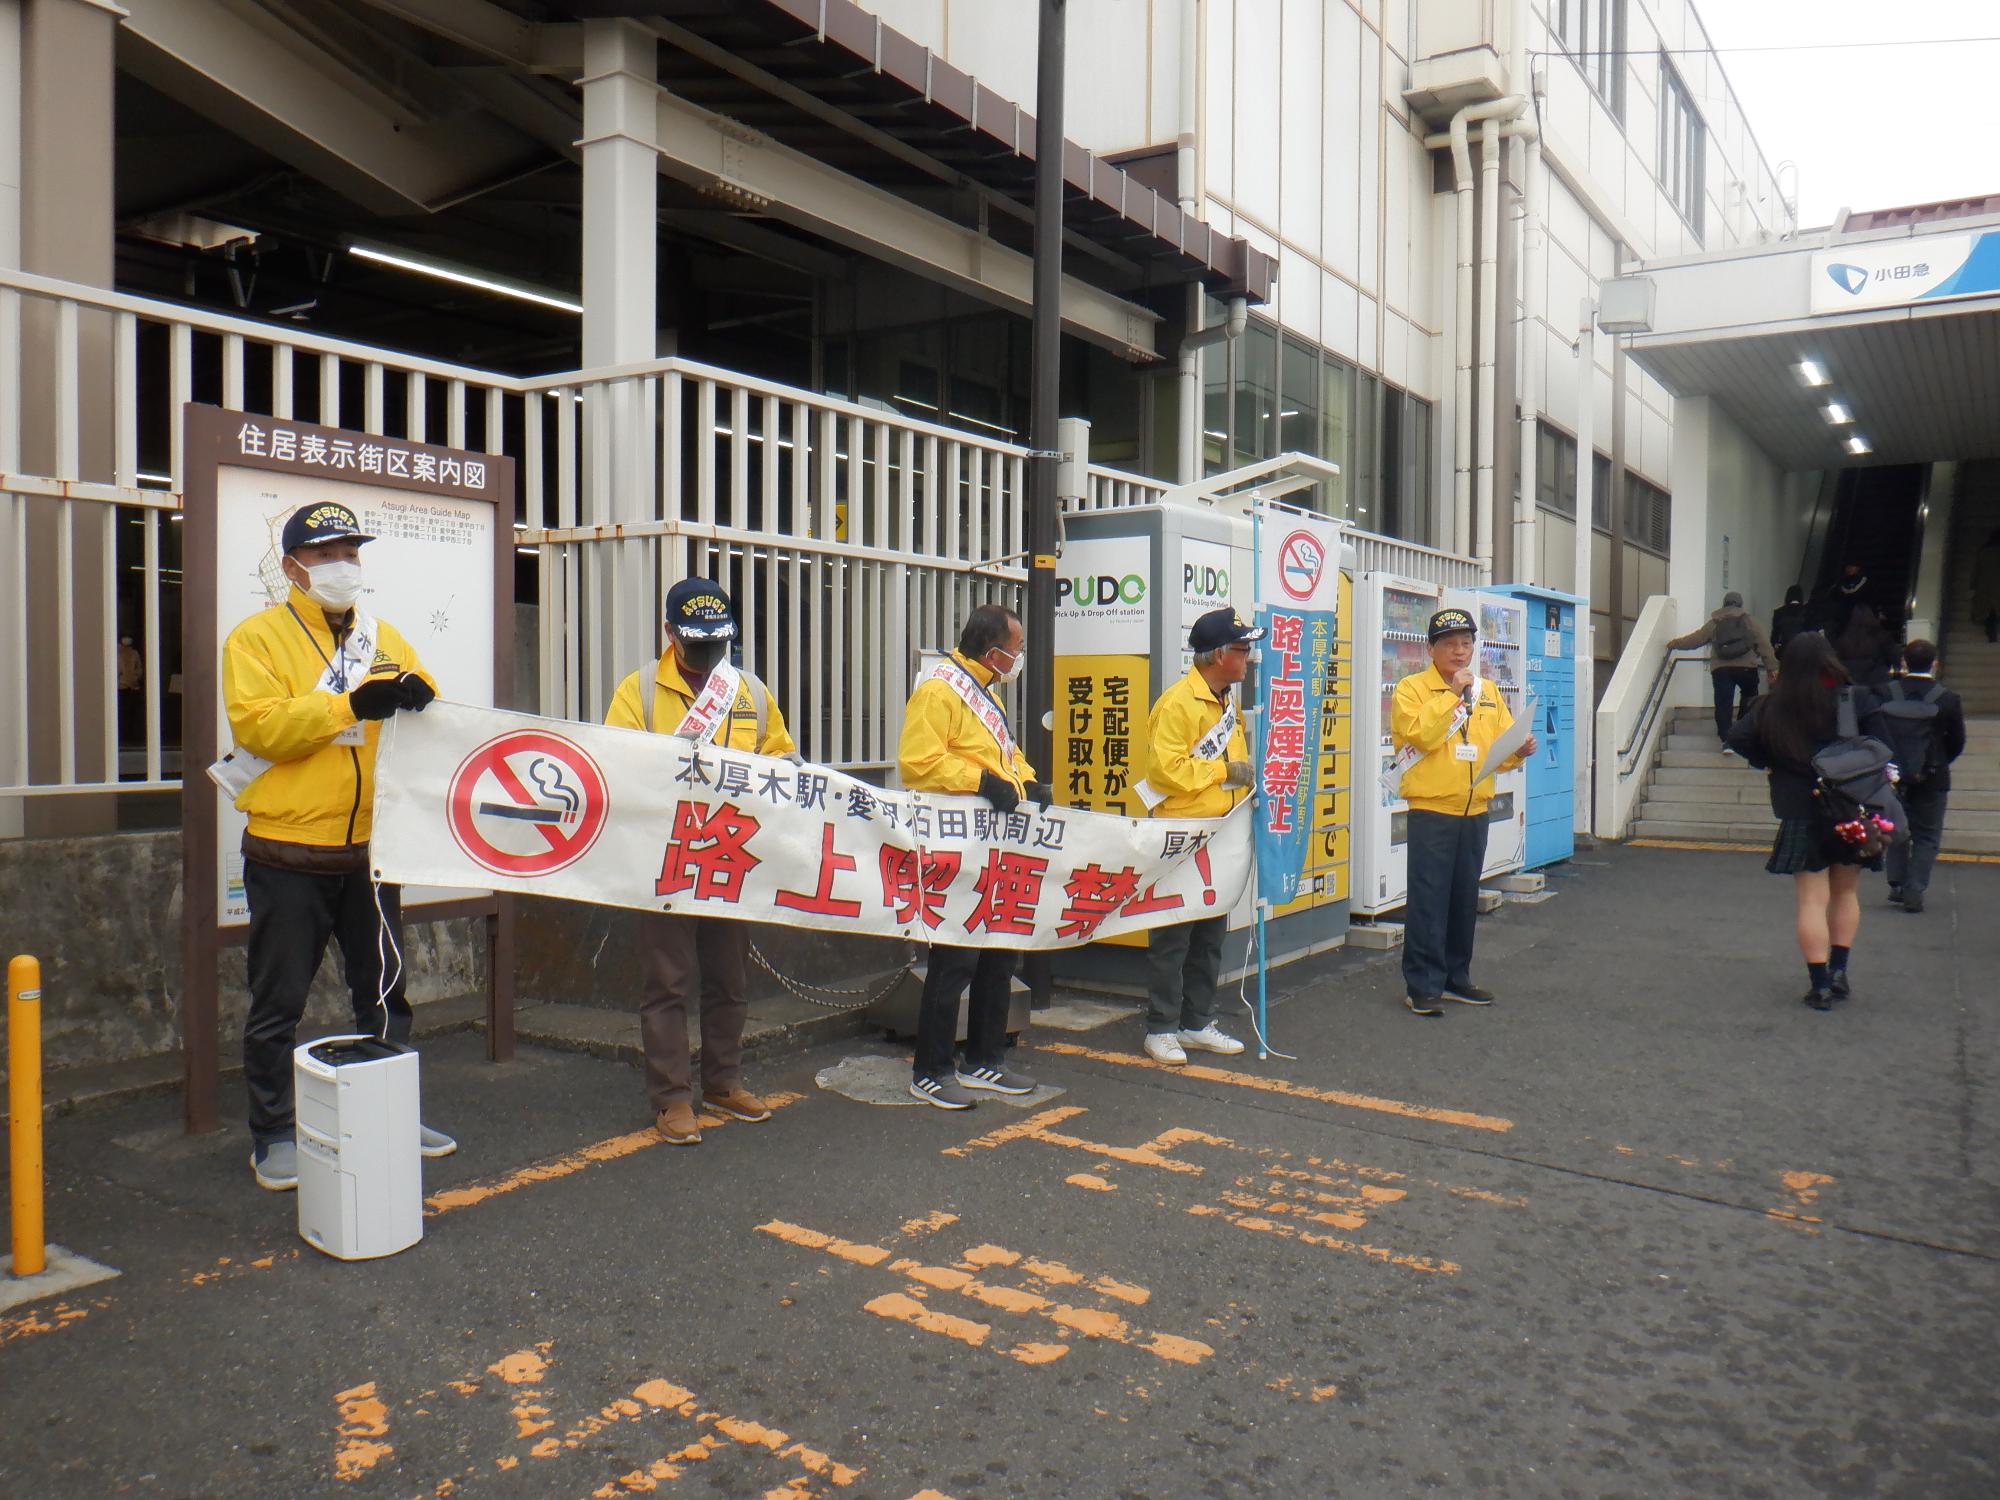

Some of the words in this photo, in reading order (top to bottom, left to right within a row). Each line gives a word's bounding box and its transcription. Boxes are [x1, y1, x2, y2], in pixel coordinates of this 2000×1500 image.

[1875, 263, 1930, 282] 小田急
[237, 423, 486, 490] 住居表示街区案内図
[305, 506, 355, 529] ATSUGI
[381, 501, 407, 514] Atsugi
[409, 504, 428, 515] Area
[430, 507, 452, 518] Guide
[454, 509, 471, 520] Map
[1055, 574, 1147, 607] PUDO
[1183, 563, 1230, 599] PUDO
[681, 595, 726, 616] ATSUGI
[1055, 608, 1068, 618] Pick
[1069, 610, 1080, 619] Up
[1087, 609, 1105, 619] Drop
[1106, 608, 1118, 617] Off
[1119, 608, 1145, 617] station
[1263, 613, 1305, 833] 路上喫煙禁止
[1160, 829, 1217, 860] 厚木
